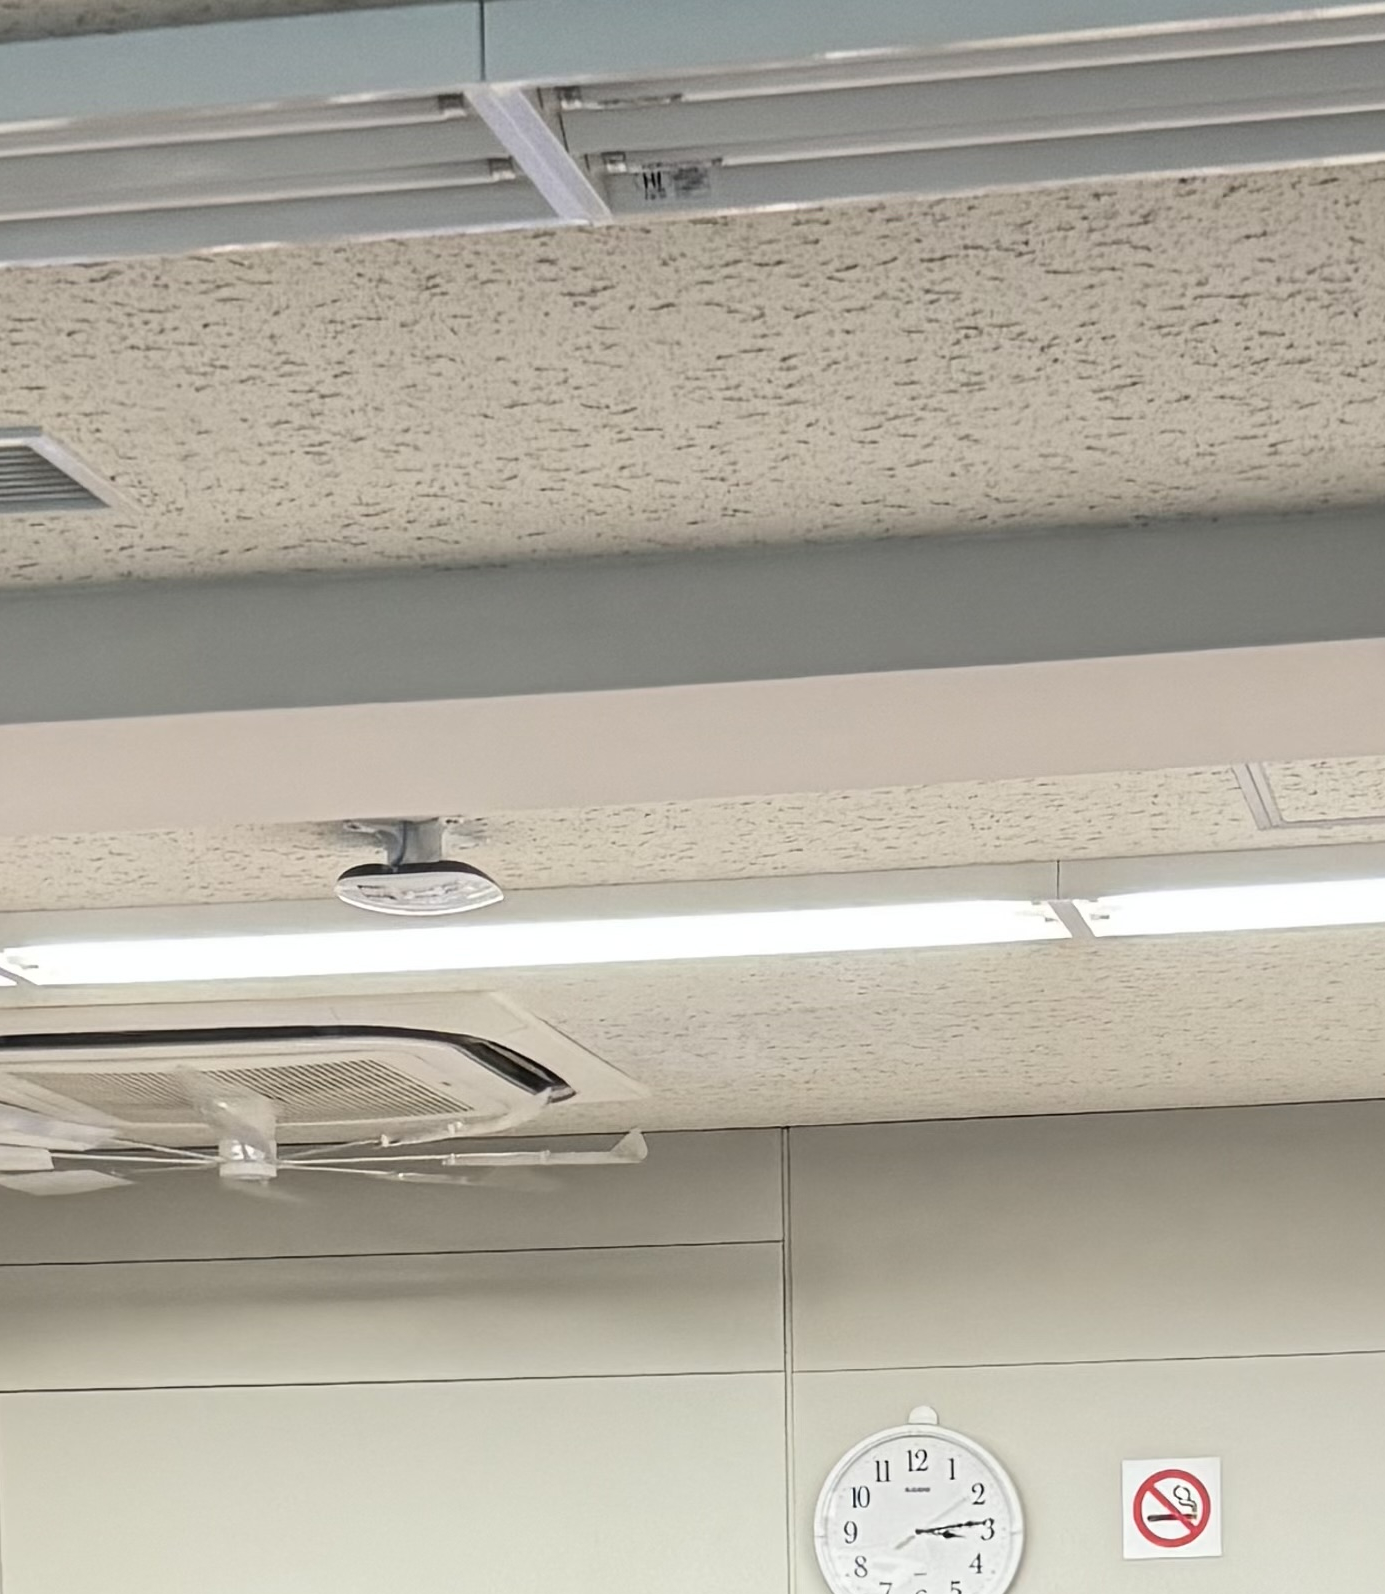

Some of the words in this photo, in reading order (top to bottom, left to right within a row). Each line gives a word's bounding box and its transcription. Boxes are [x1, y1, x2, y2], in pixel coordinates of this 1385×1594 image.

[875, 1460, 891, 1482] 11
[907, 1449, 929, 1472] 12
[949, 1458, 956, 1480] 1
[851, 1486, 871, 1508] 10
[972, 1483, 986, 1505] 2
[843, 1521, 858, 1544] 9
[981, 1518, 995, 1541] 3
[854, 1556, 868, 1578] 8
[969, 1553, 984, 1574] 4
